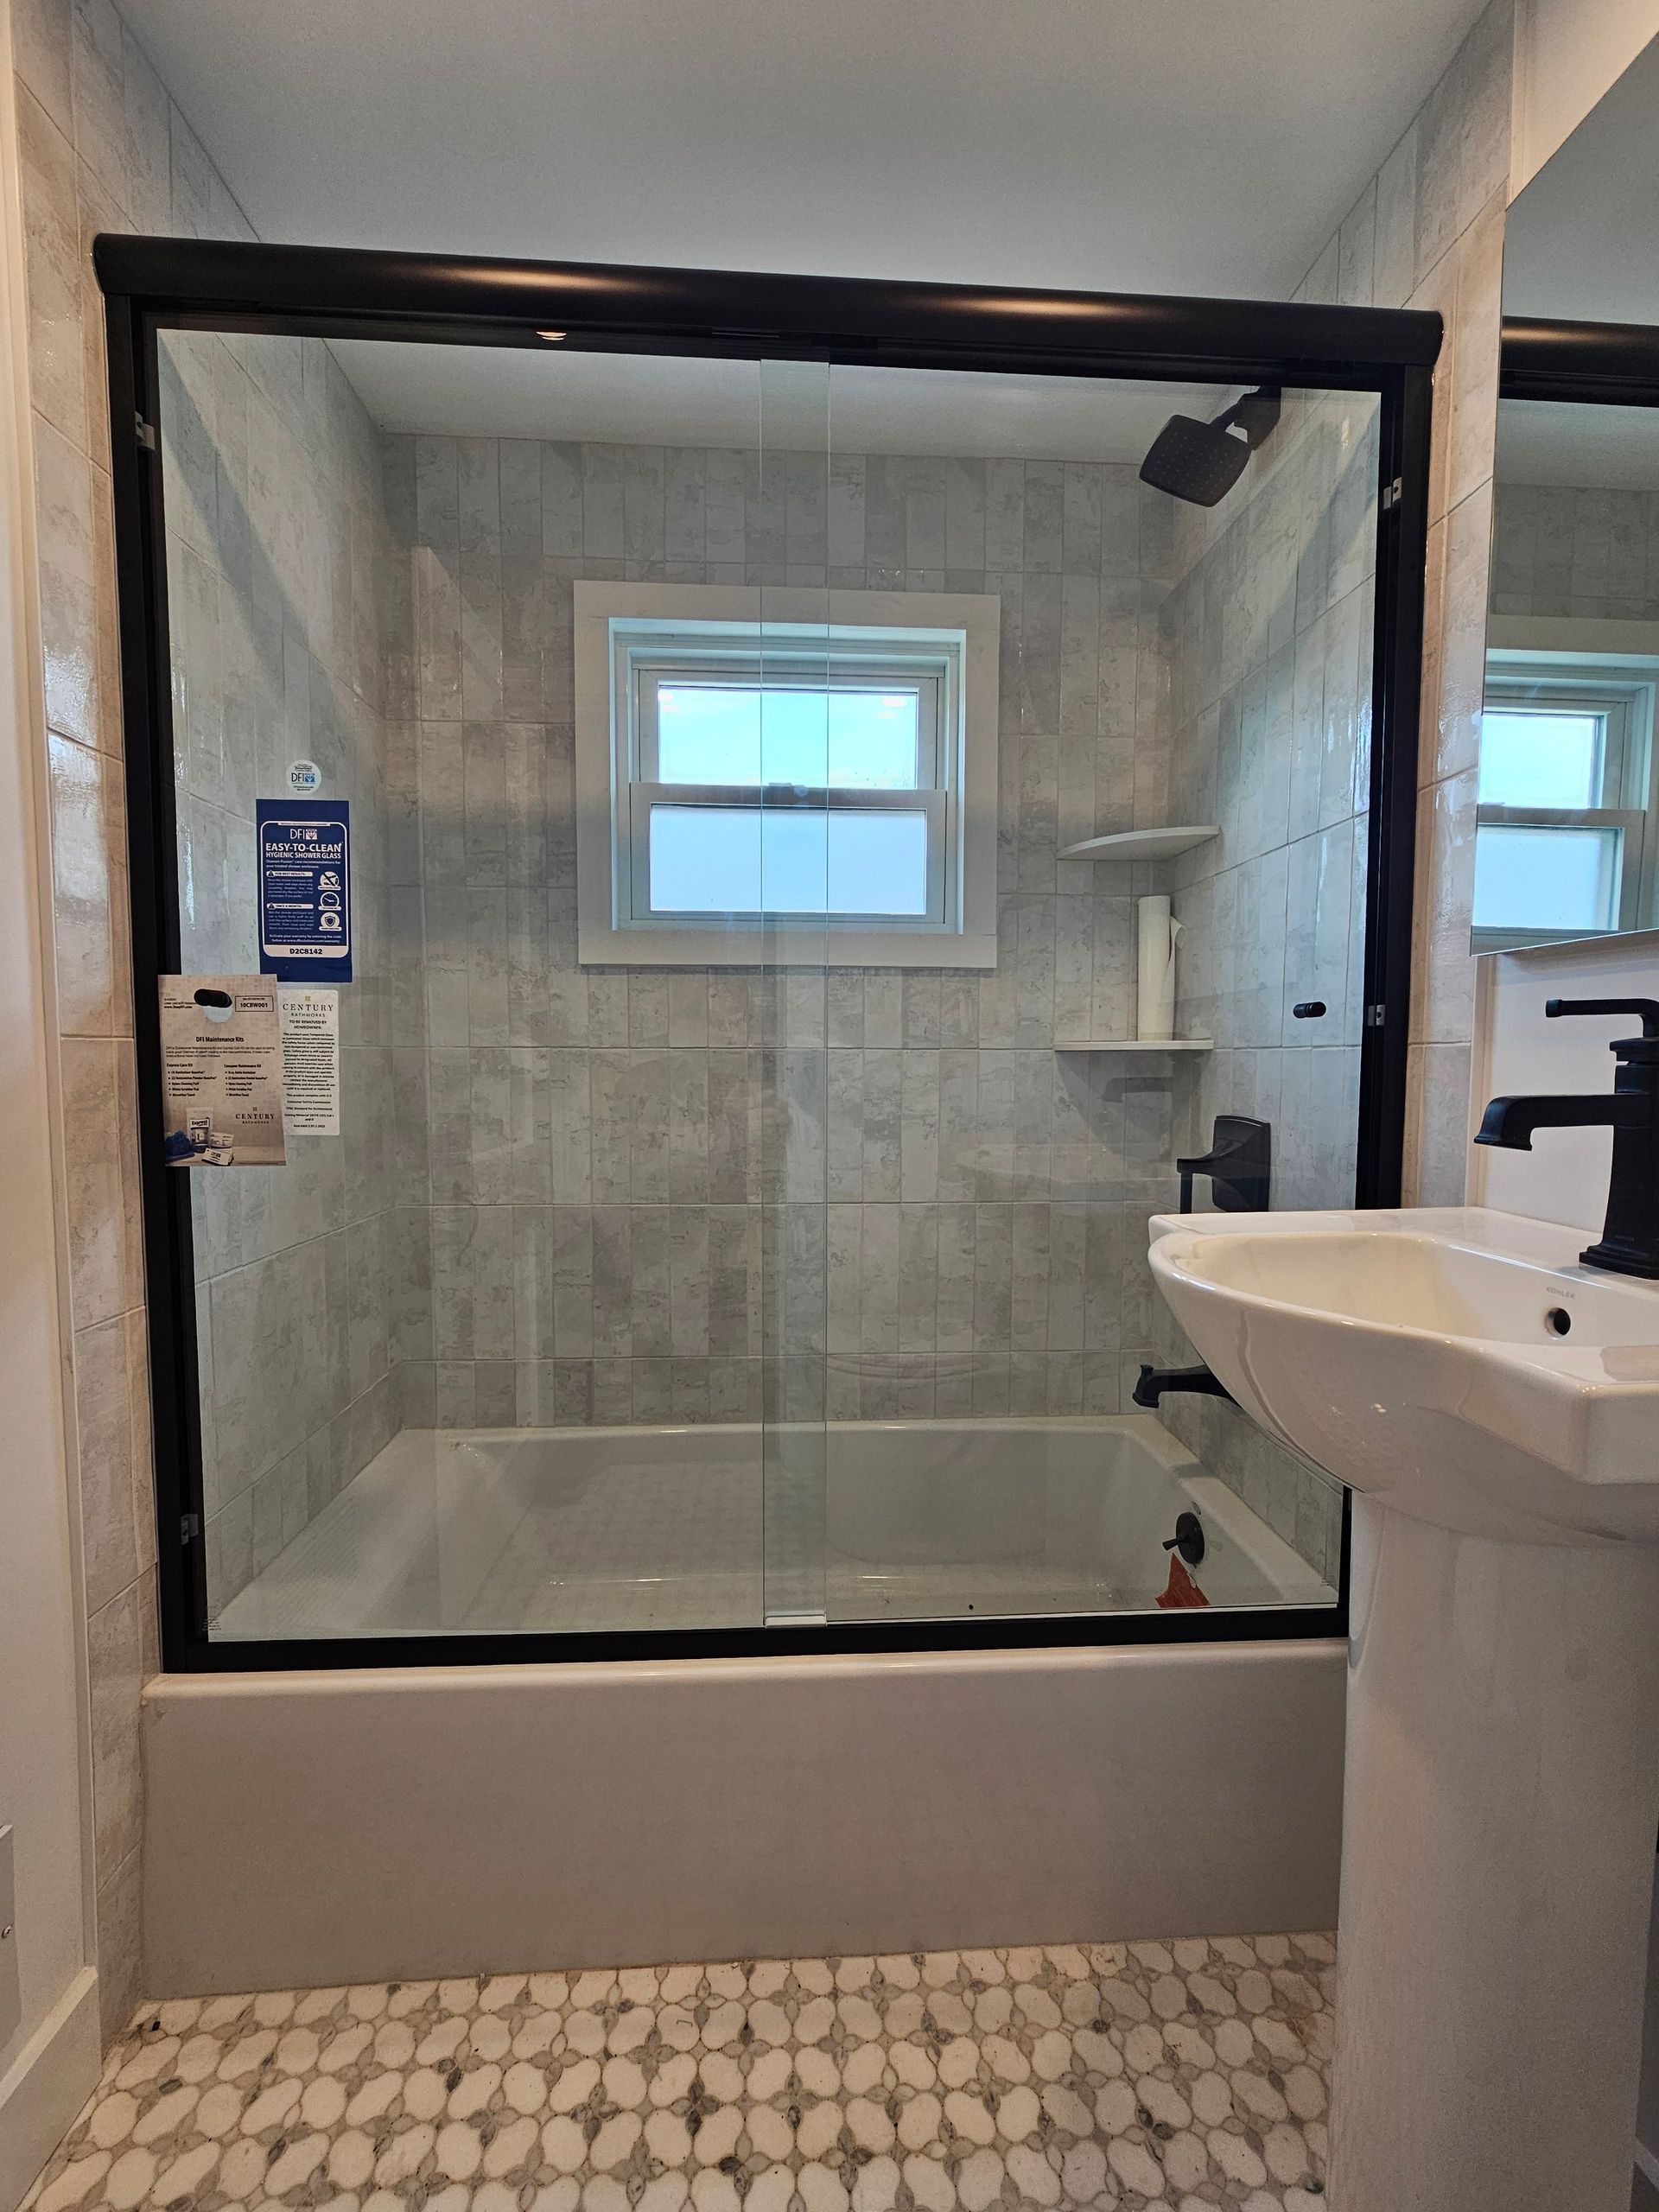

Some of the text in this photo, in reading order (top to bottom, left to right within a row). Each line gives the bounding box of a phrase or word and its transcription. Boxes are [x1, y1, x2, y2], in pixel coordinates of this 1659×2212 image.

[291, 772, 304, 782] DFI
[290, 829, 305, 839] DFI
[265, 842, 341, 853] EASY-TO-CLEAN
